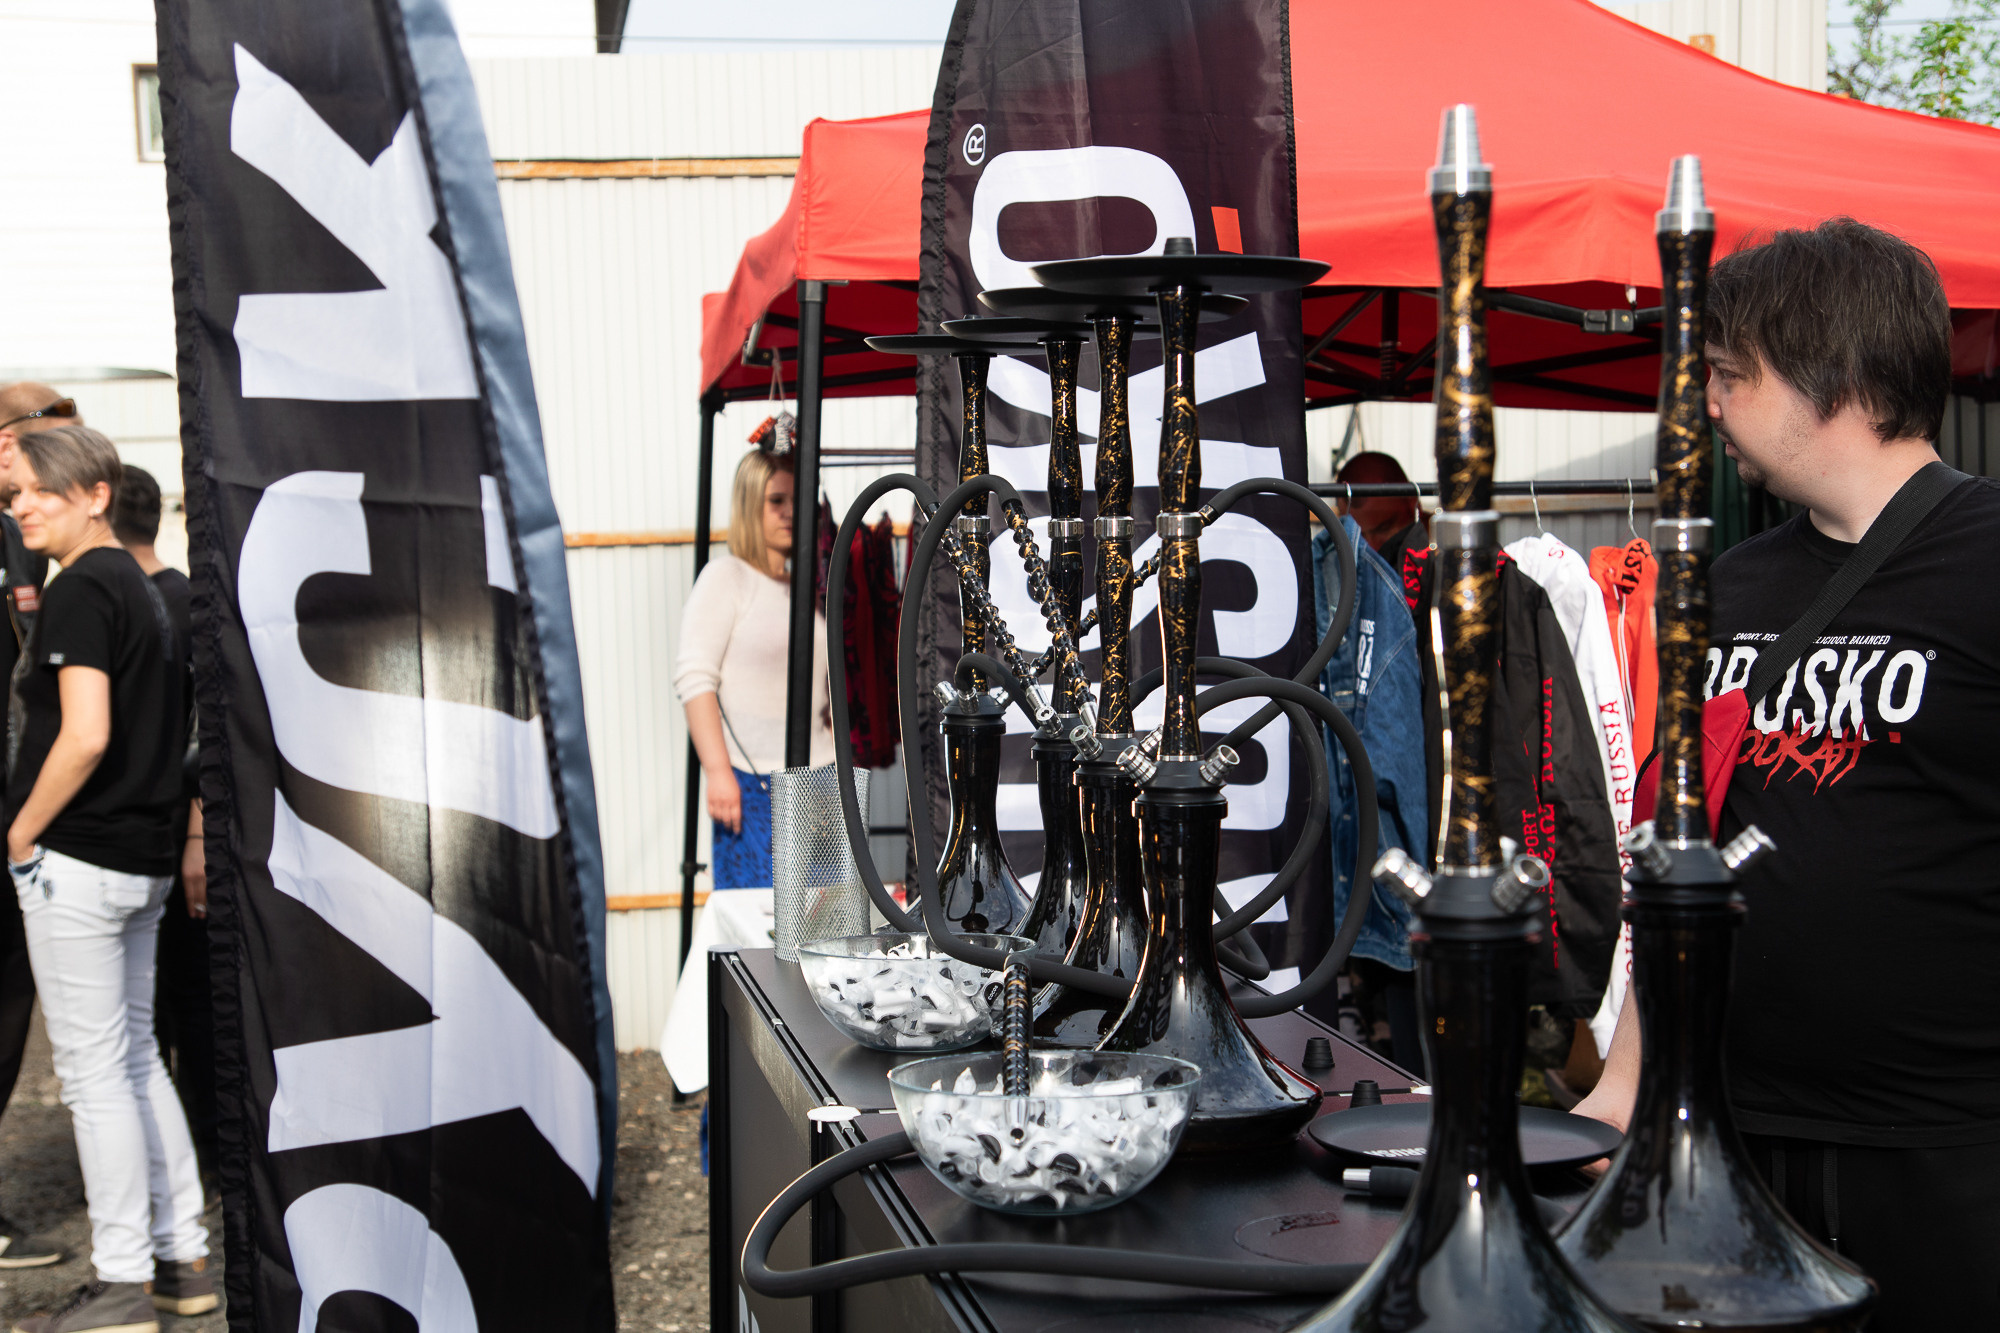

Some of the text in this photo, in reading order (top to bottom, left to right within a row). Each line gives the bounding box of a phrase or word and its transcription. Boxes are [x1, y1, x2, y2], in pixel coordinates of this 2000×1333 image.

[1813, 635, 1848, 645] LICIOUS.
[1849, 635, 1891, 645] BALANCED
[1598, 699, 1634, 805] RUSSIA
